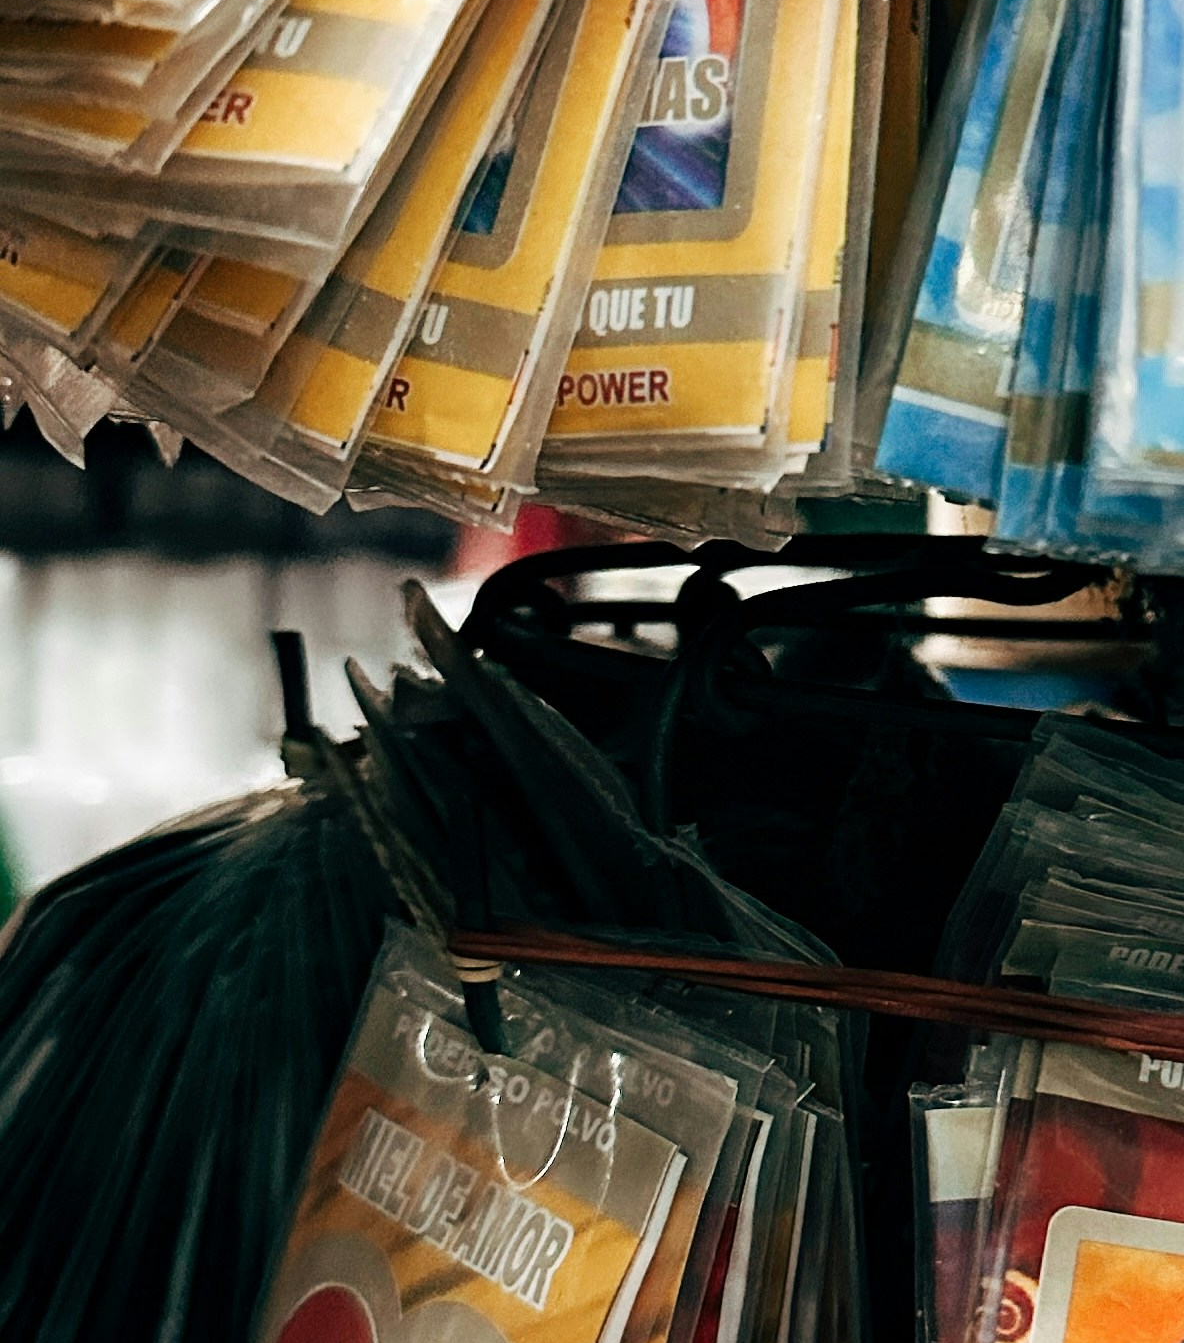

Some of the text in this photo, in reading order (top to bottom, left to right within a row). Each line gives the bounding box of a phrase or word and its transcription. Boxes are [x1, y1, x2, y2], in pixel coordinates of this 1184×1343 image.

[637, 54, 729, 128] AS
[588, 284, 695, 336] QUE TU
[557, 368, 670, 407] POWER
[338, 1107, 575, 1312] MIEL DE AMOR
